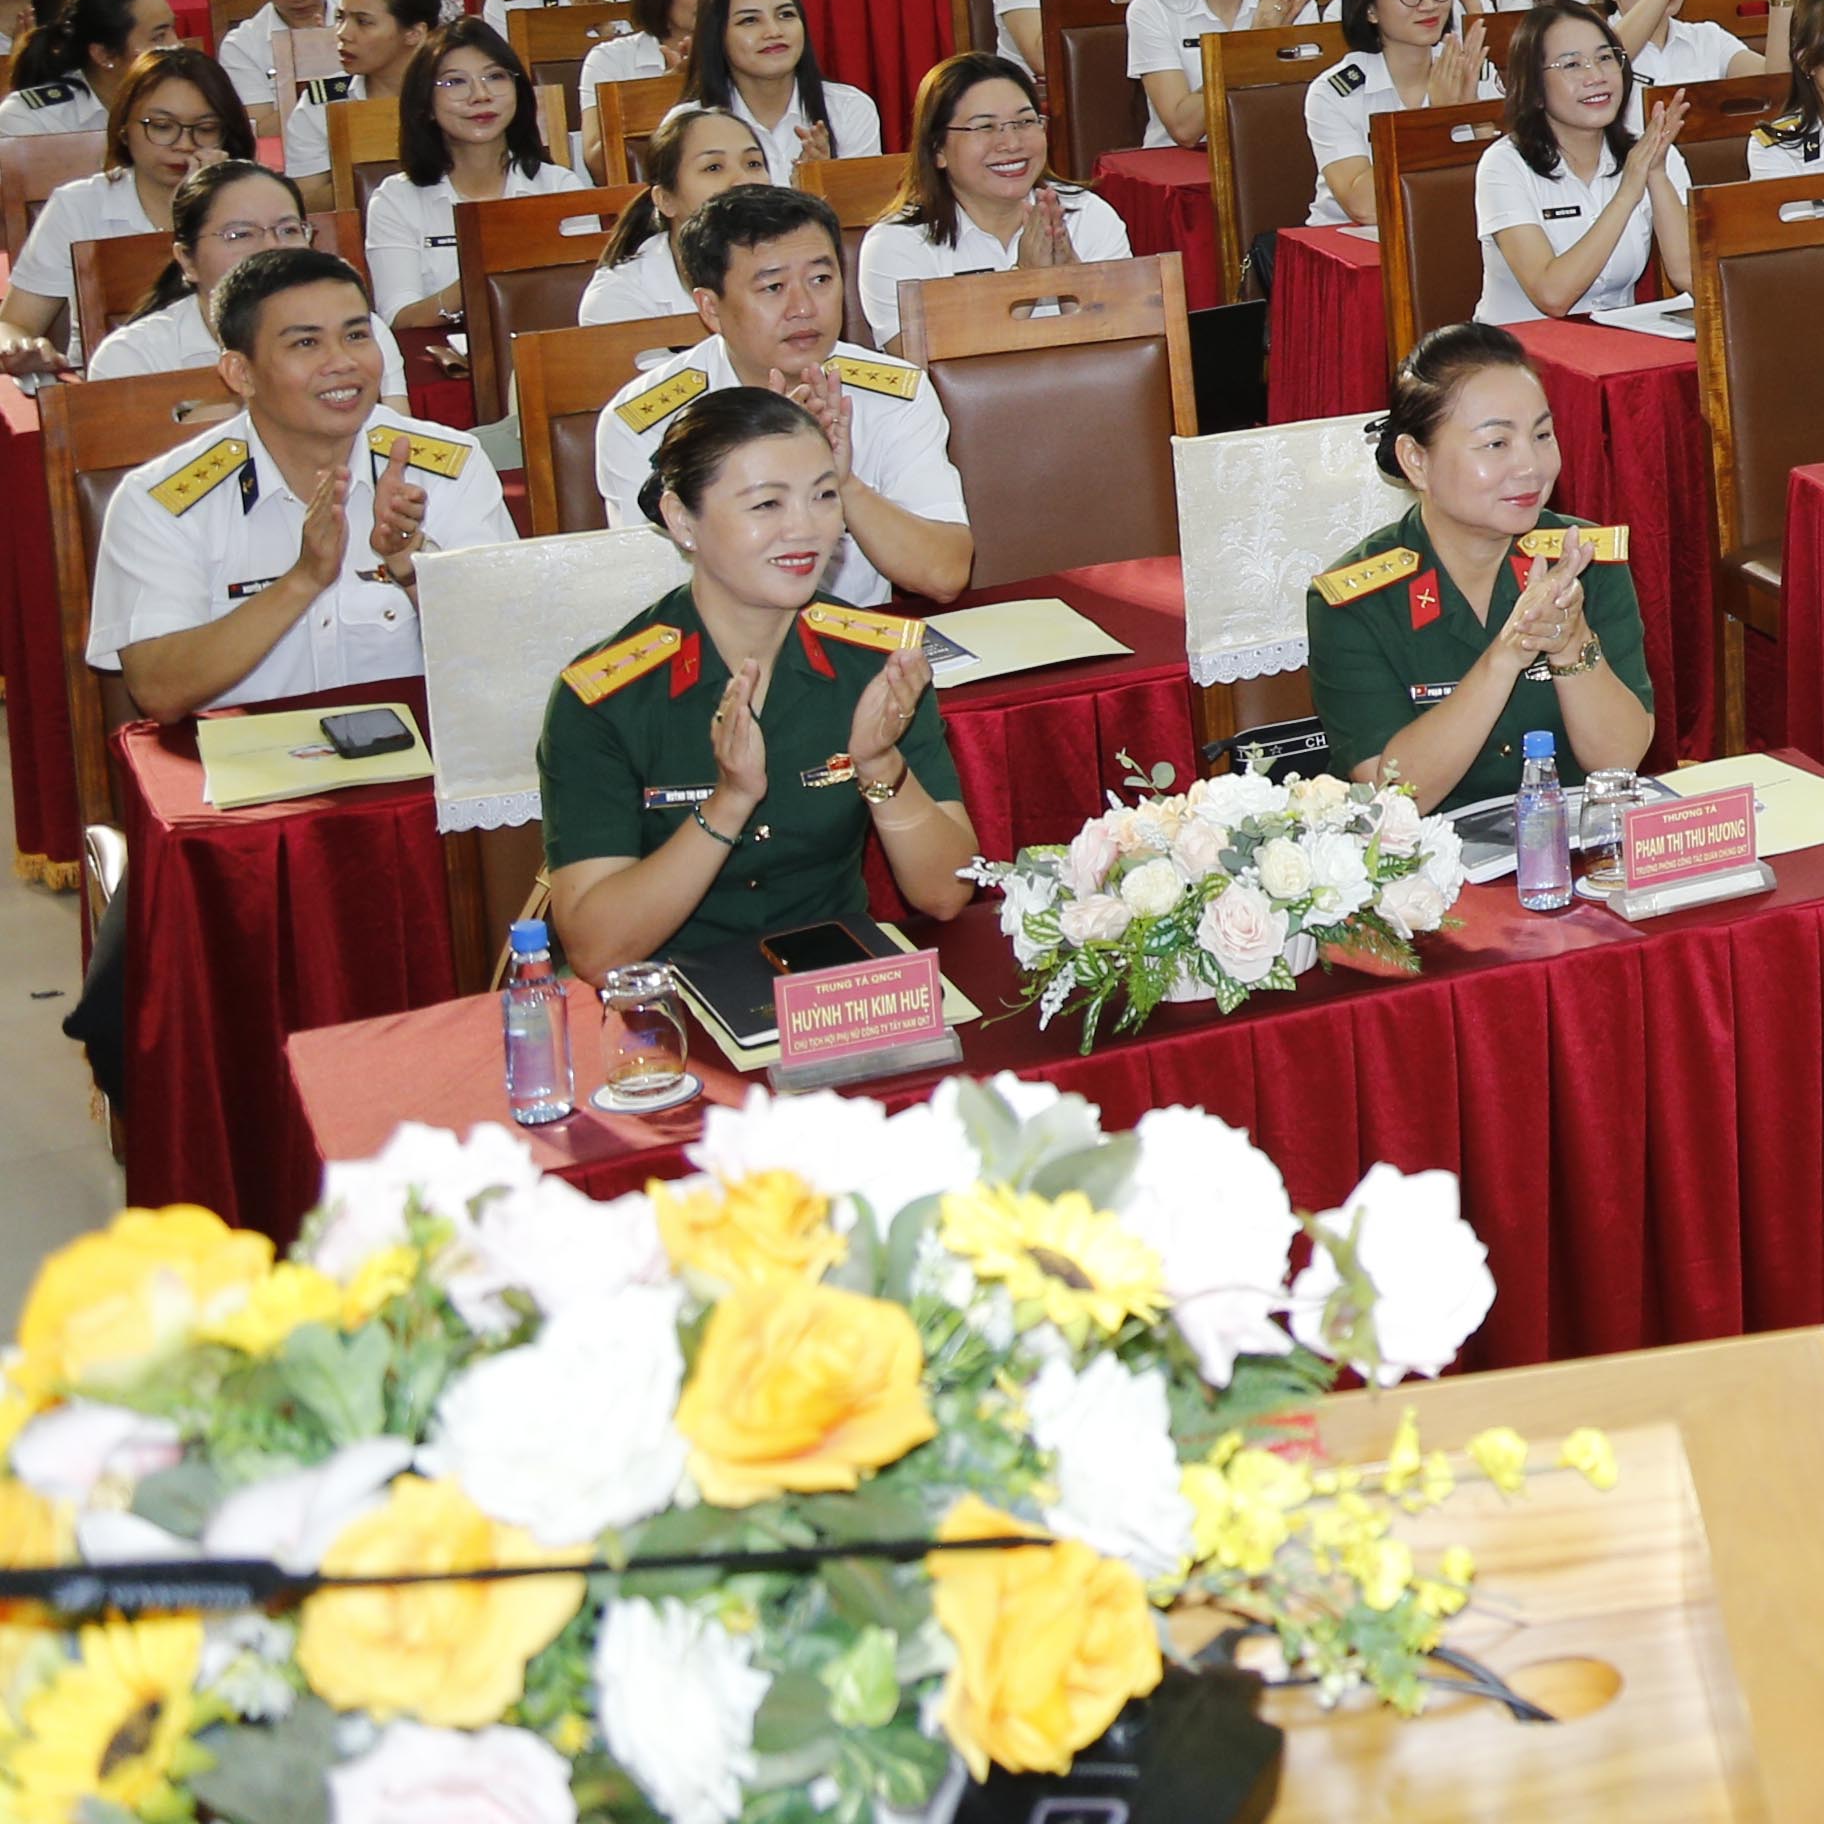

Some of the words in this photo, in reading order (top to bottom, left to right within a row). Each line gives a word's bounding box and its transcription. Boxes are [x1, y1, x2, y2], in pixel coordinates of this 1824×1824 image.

[1662, 807, 1703, 824] THƯỢNG
[1705, 803, 1717, 814] TÁ
[1635, 835, 1665, 861] PHẠM
[1666, 831, 1684, 855] THỊ
[1685, 826, 1706, 849] THU
[1707, 818, 1746, 845] HƯƠNG
[815, 978, 852, 995] TRUNG
[855, 974, 868, 987] TÁ
[871, 970, 902, 983] QNCN
[791, 1003, 842, 1034] HUỲNH
[844, 997, 869, 1024] THỊ
[871, 992, 897, 1018] KIM
[900, 984, 930, 1014] HUỆ
[861, 1025, 880, 1038] CÔNG
[880, 1023, 889, 1033] TY
